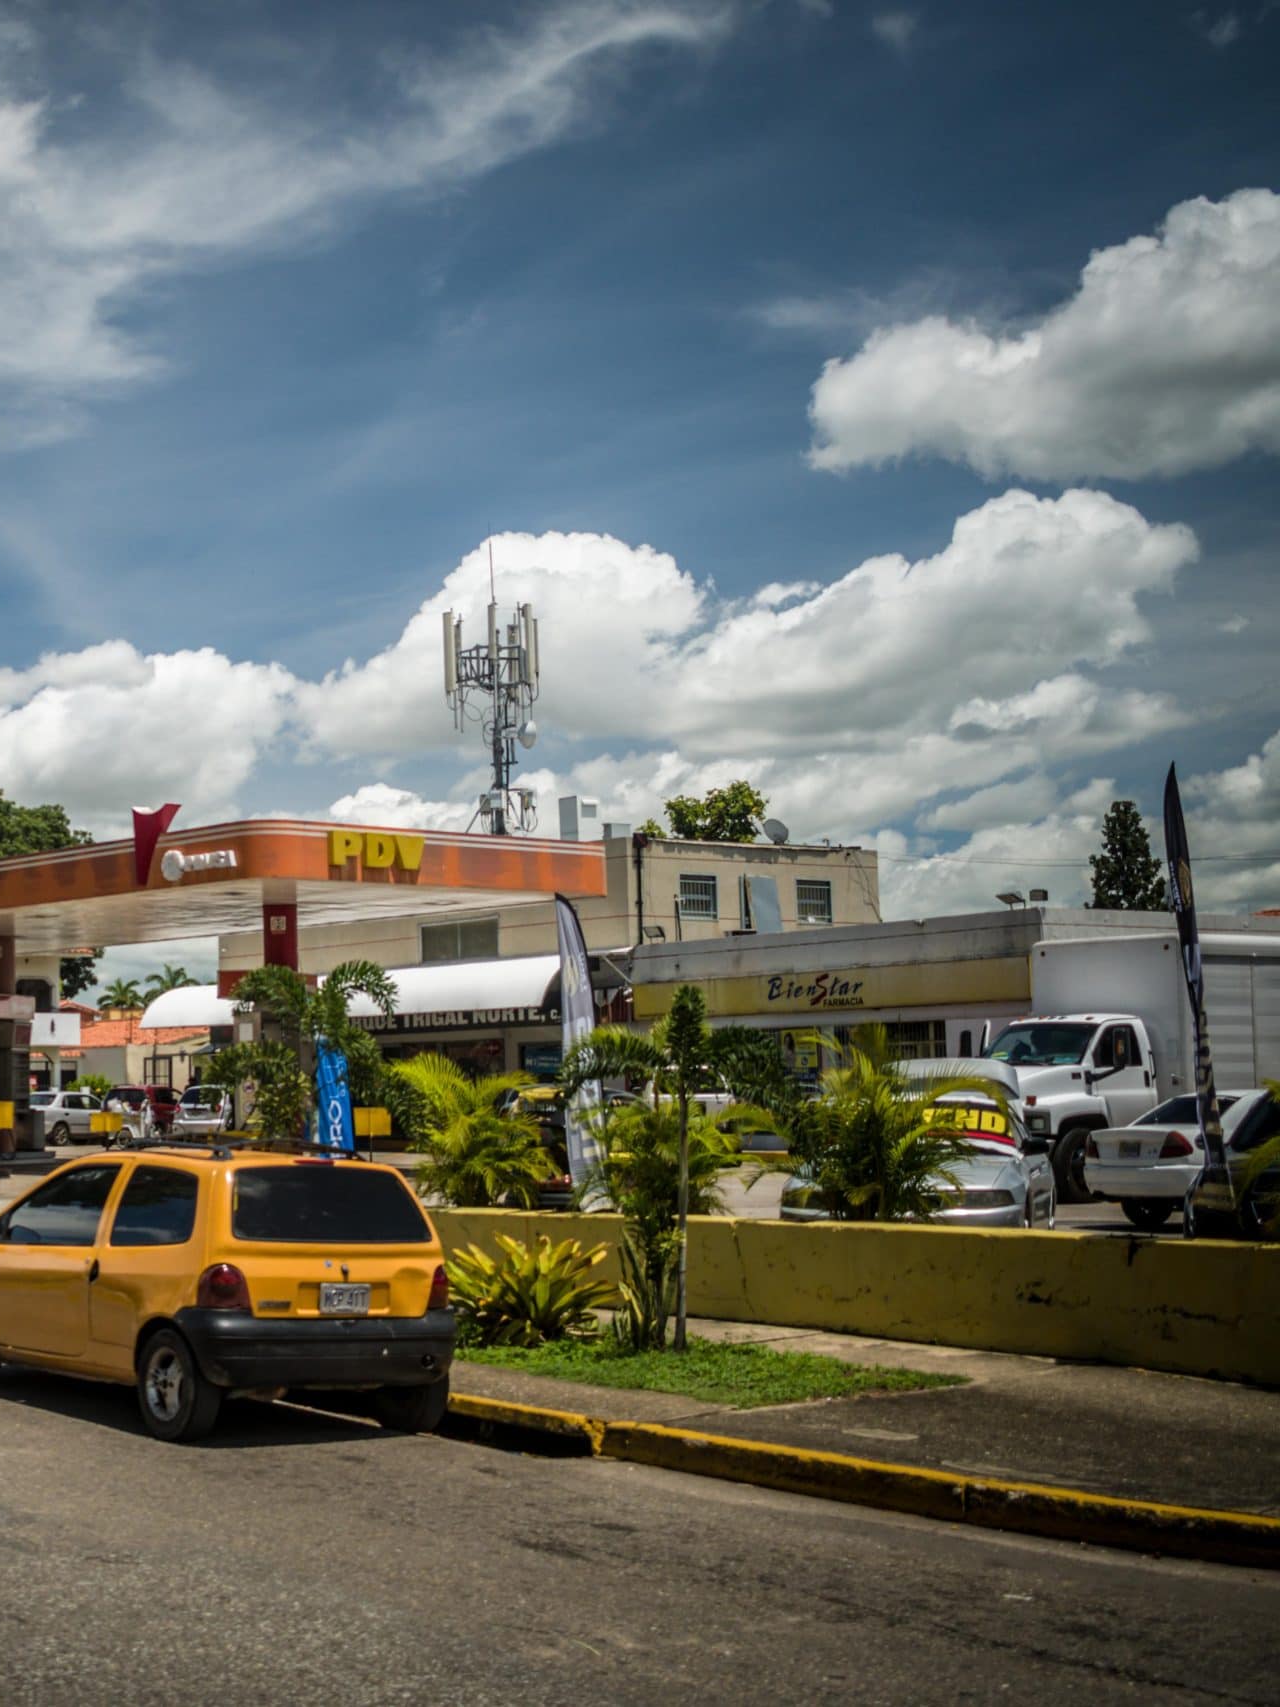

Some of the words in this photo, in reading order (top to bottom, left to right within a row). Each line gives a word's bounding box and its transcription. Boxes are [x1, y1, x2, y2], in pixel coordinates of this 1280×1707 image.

[328, 831, 425, 871] PDV
[823, 997, 864, 1008] FARMACIA
[350, 1014, 397, 1030] RQUE
[402, 1011, 469, 1028] TRIGAL
